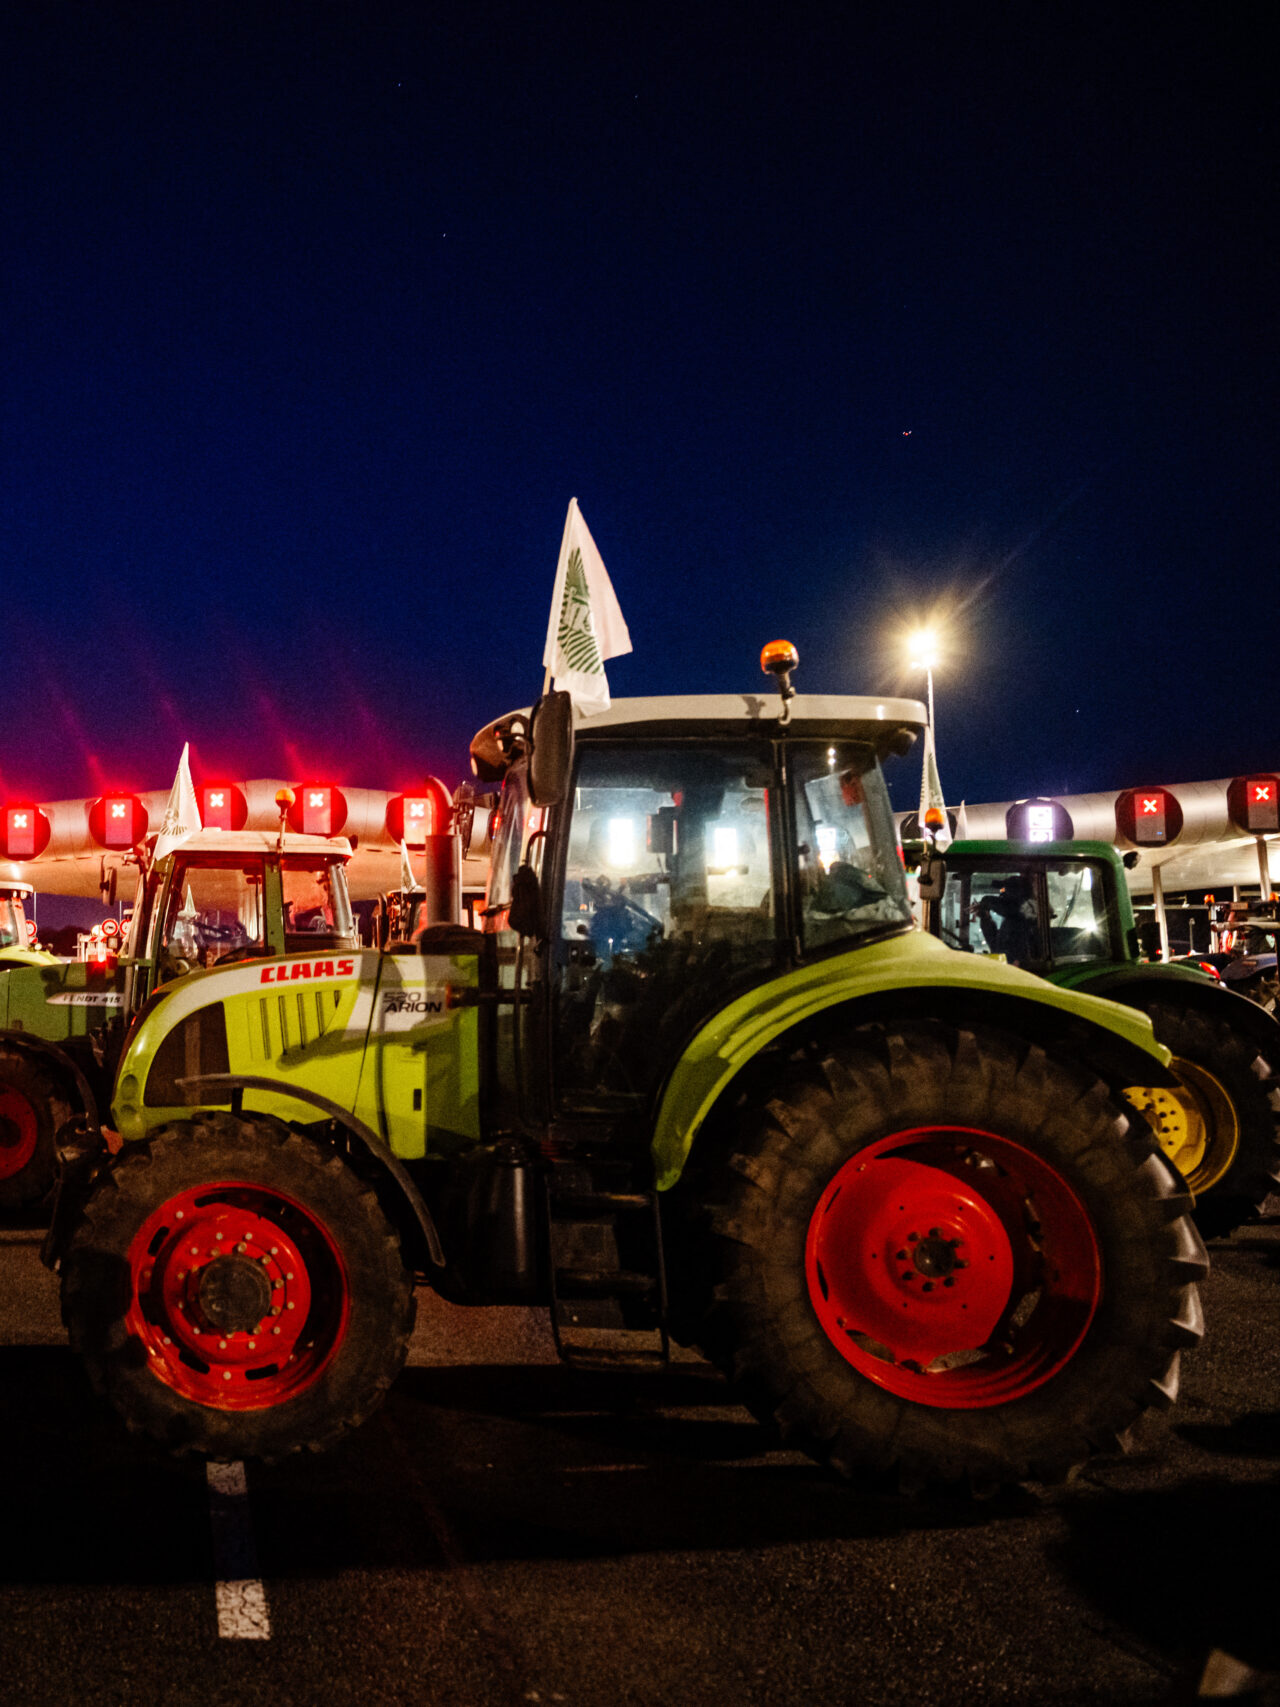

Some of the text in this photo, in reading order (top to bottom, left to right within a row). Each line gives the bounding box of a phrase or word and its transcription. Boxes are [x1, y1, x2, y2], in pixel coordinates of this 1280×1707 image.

[260, 959, 354, 984] CLAAS
[383, 991, 422, 1003] 520
[384, 1001, 442, 1013] ARION
